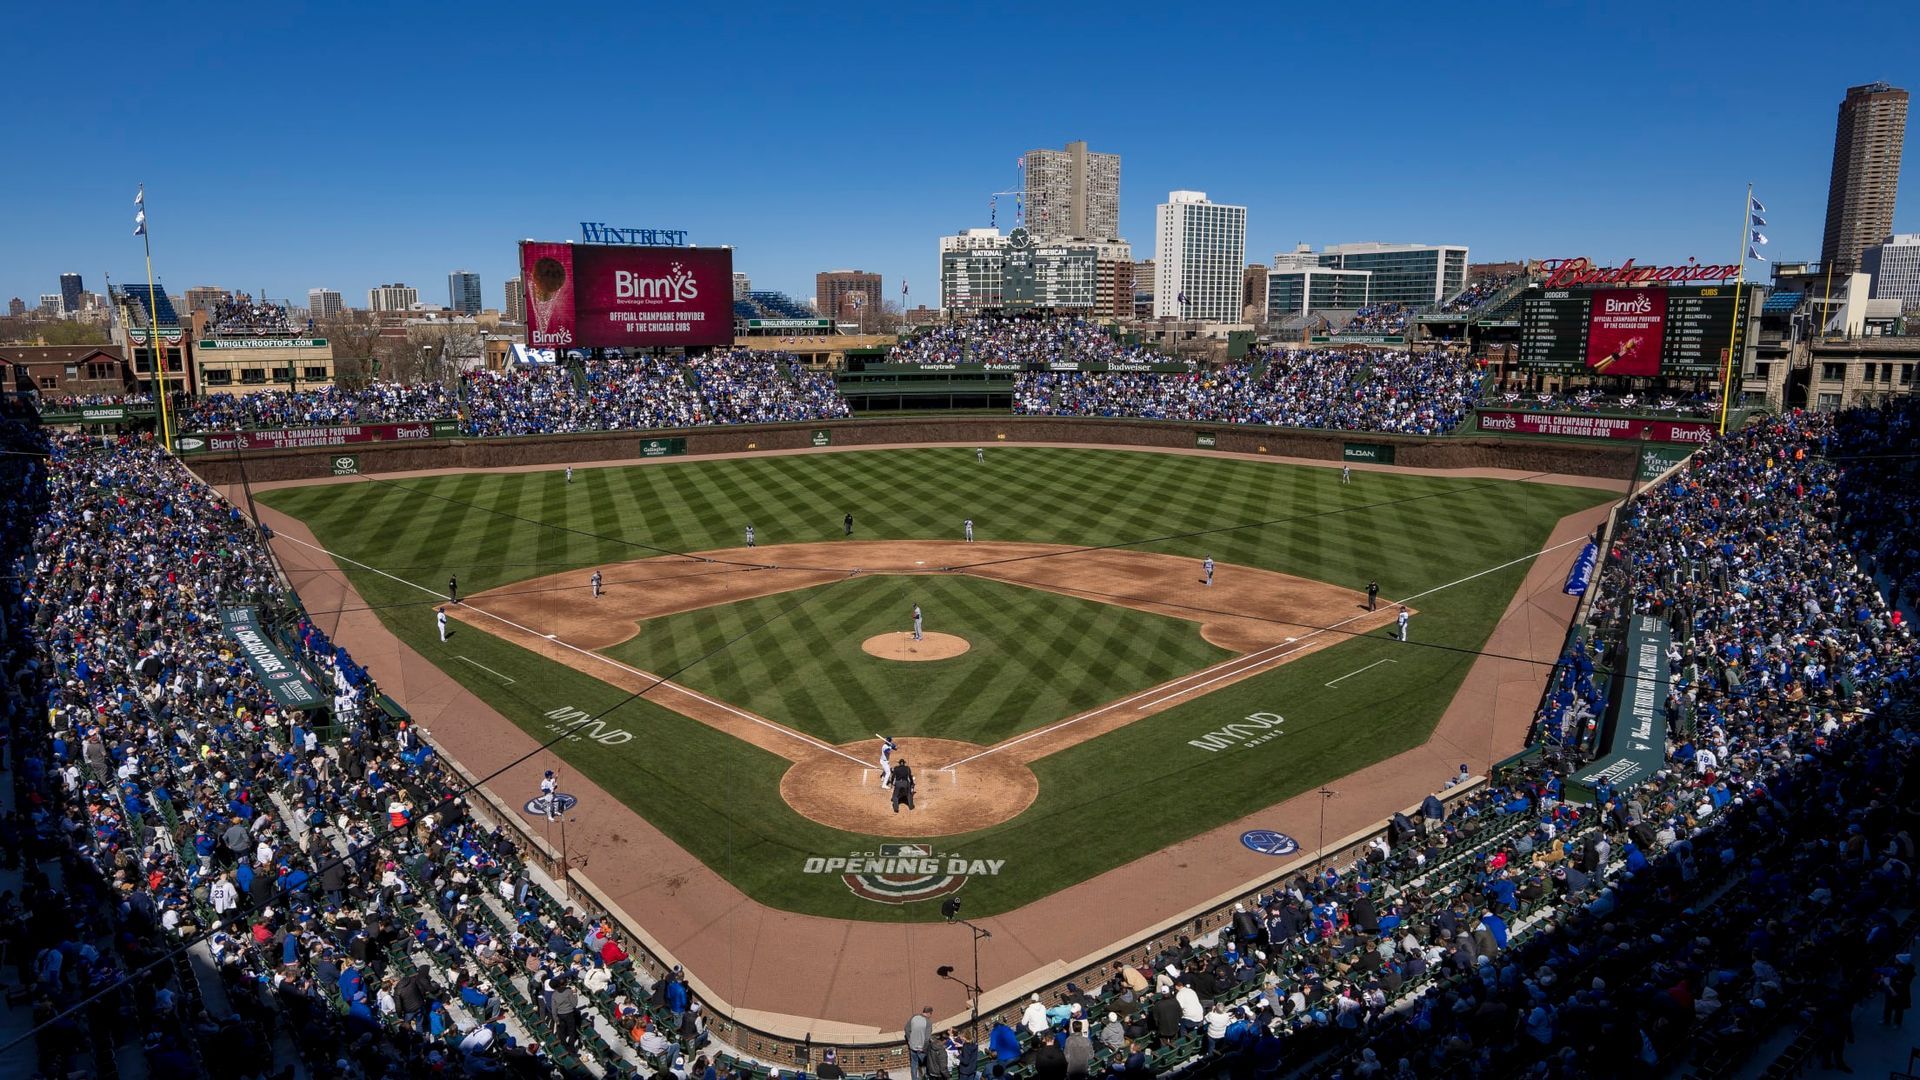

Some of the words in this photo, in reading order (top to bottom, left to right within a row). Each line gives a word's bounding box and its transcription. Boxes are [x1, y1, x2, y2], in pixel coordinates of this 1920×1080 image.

[580, 222, 687, 246] WINTRUST
[1540, 257, 1743, 288] Budweiser
[1701, 288, 1718, 296] CUBS
[610, 312, 637, 321] OFFICIAL
[639, 312, 675, 321] CHAMPAGNE
[676, 312, 705, 321] PROVIDER
[627, 323, 634, 332] OF
[636, 323, 647, 332] THE
[648, 323, 674, 332] CHICAGO
[675, 323, 690, 332] CUBS
[760, 319, 819, 327] WRIGLEYROOFTOPS.COM
[215, 339, 313, 348] WRIGLEYROOFTOPS.COM
[1108, 362, 1151, 371] Budweiser
[83, 409, 123, 417] GRAINGER
[1523, 415, 1551, 425] OFFICIAL
[1553, 416, 1594, 427] CHAMPAGNE
[1595, 418, 1629, 429] PROVIDER
[256, 431, 287, 440] OFFICIAL
[288, 429, 328, 439] CHAMPAGNE
[329, 426, 361, 437] PROVIDER
[1539, 425, 1547, 433] OF
[1549, 425, 1560, 434] THE
[1562, 426, 1592, 436] CHICAGO
[1593, 428, 1610, 437] CUBS
[274, 439, 284, 448] OF
[285, 438, 298, 448] THE
[299, 436, 327, 447] CHICAGO
[328, 435, 345, 445] CUBS
[1345, 449, 1375, 457] SLOAN
[334, 468, 358, 476] TOYOTA
[236, 630, 270, 655] CHICAGO
[255, 653, 286, 673] CUBS
[1187, 712, 1285, 752] MYND
[1243, 729, 1284, 748] DRINKS
[803, 857, 940, 874] OPENING
[947, 859, 1006, 876] DAY
[214, 890, 225, 899] 23
